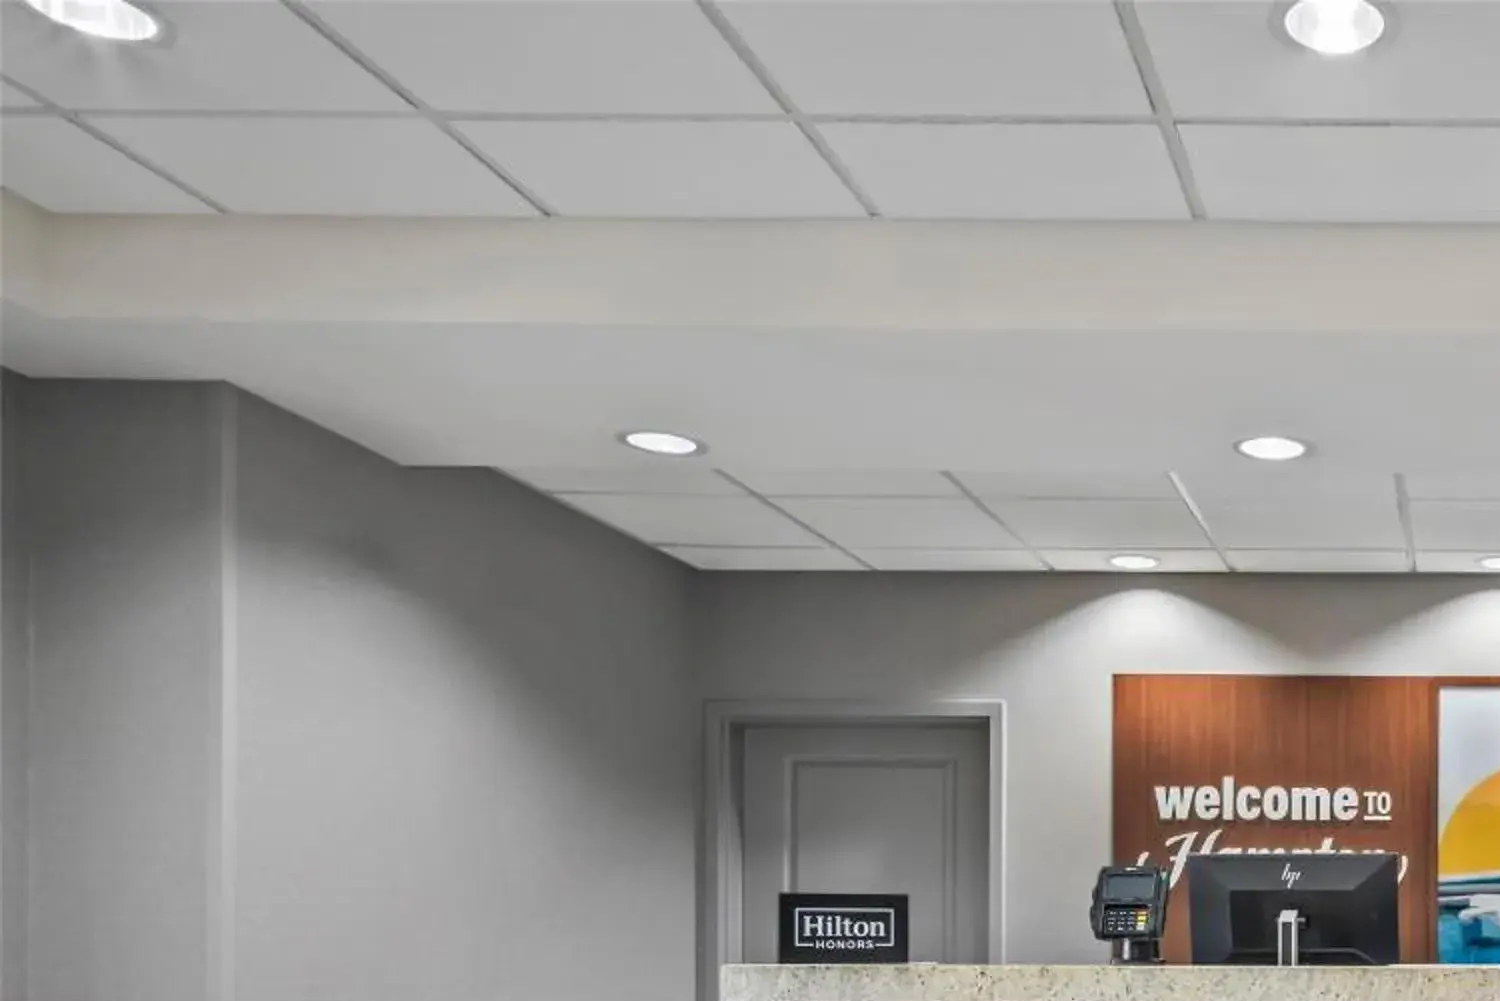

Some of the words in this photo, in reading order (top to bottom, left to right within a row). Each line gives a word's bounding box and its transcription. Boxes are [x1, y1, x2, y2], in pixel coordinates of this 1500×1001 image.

[1154, 775, 1359, 821] welcome
[1363, 790, 1392, 816] TO
[802, 915, 886, 937] Hilton
[815, 940, 875, 949] HONORS
